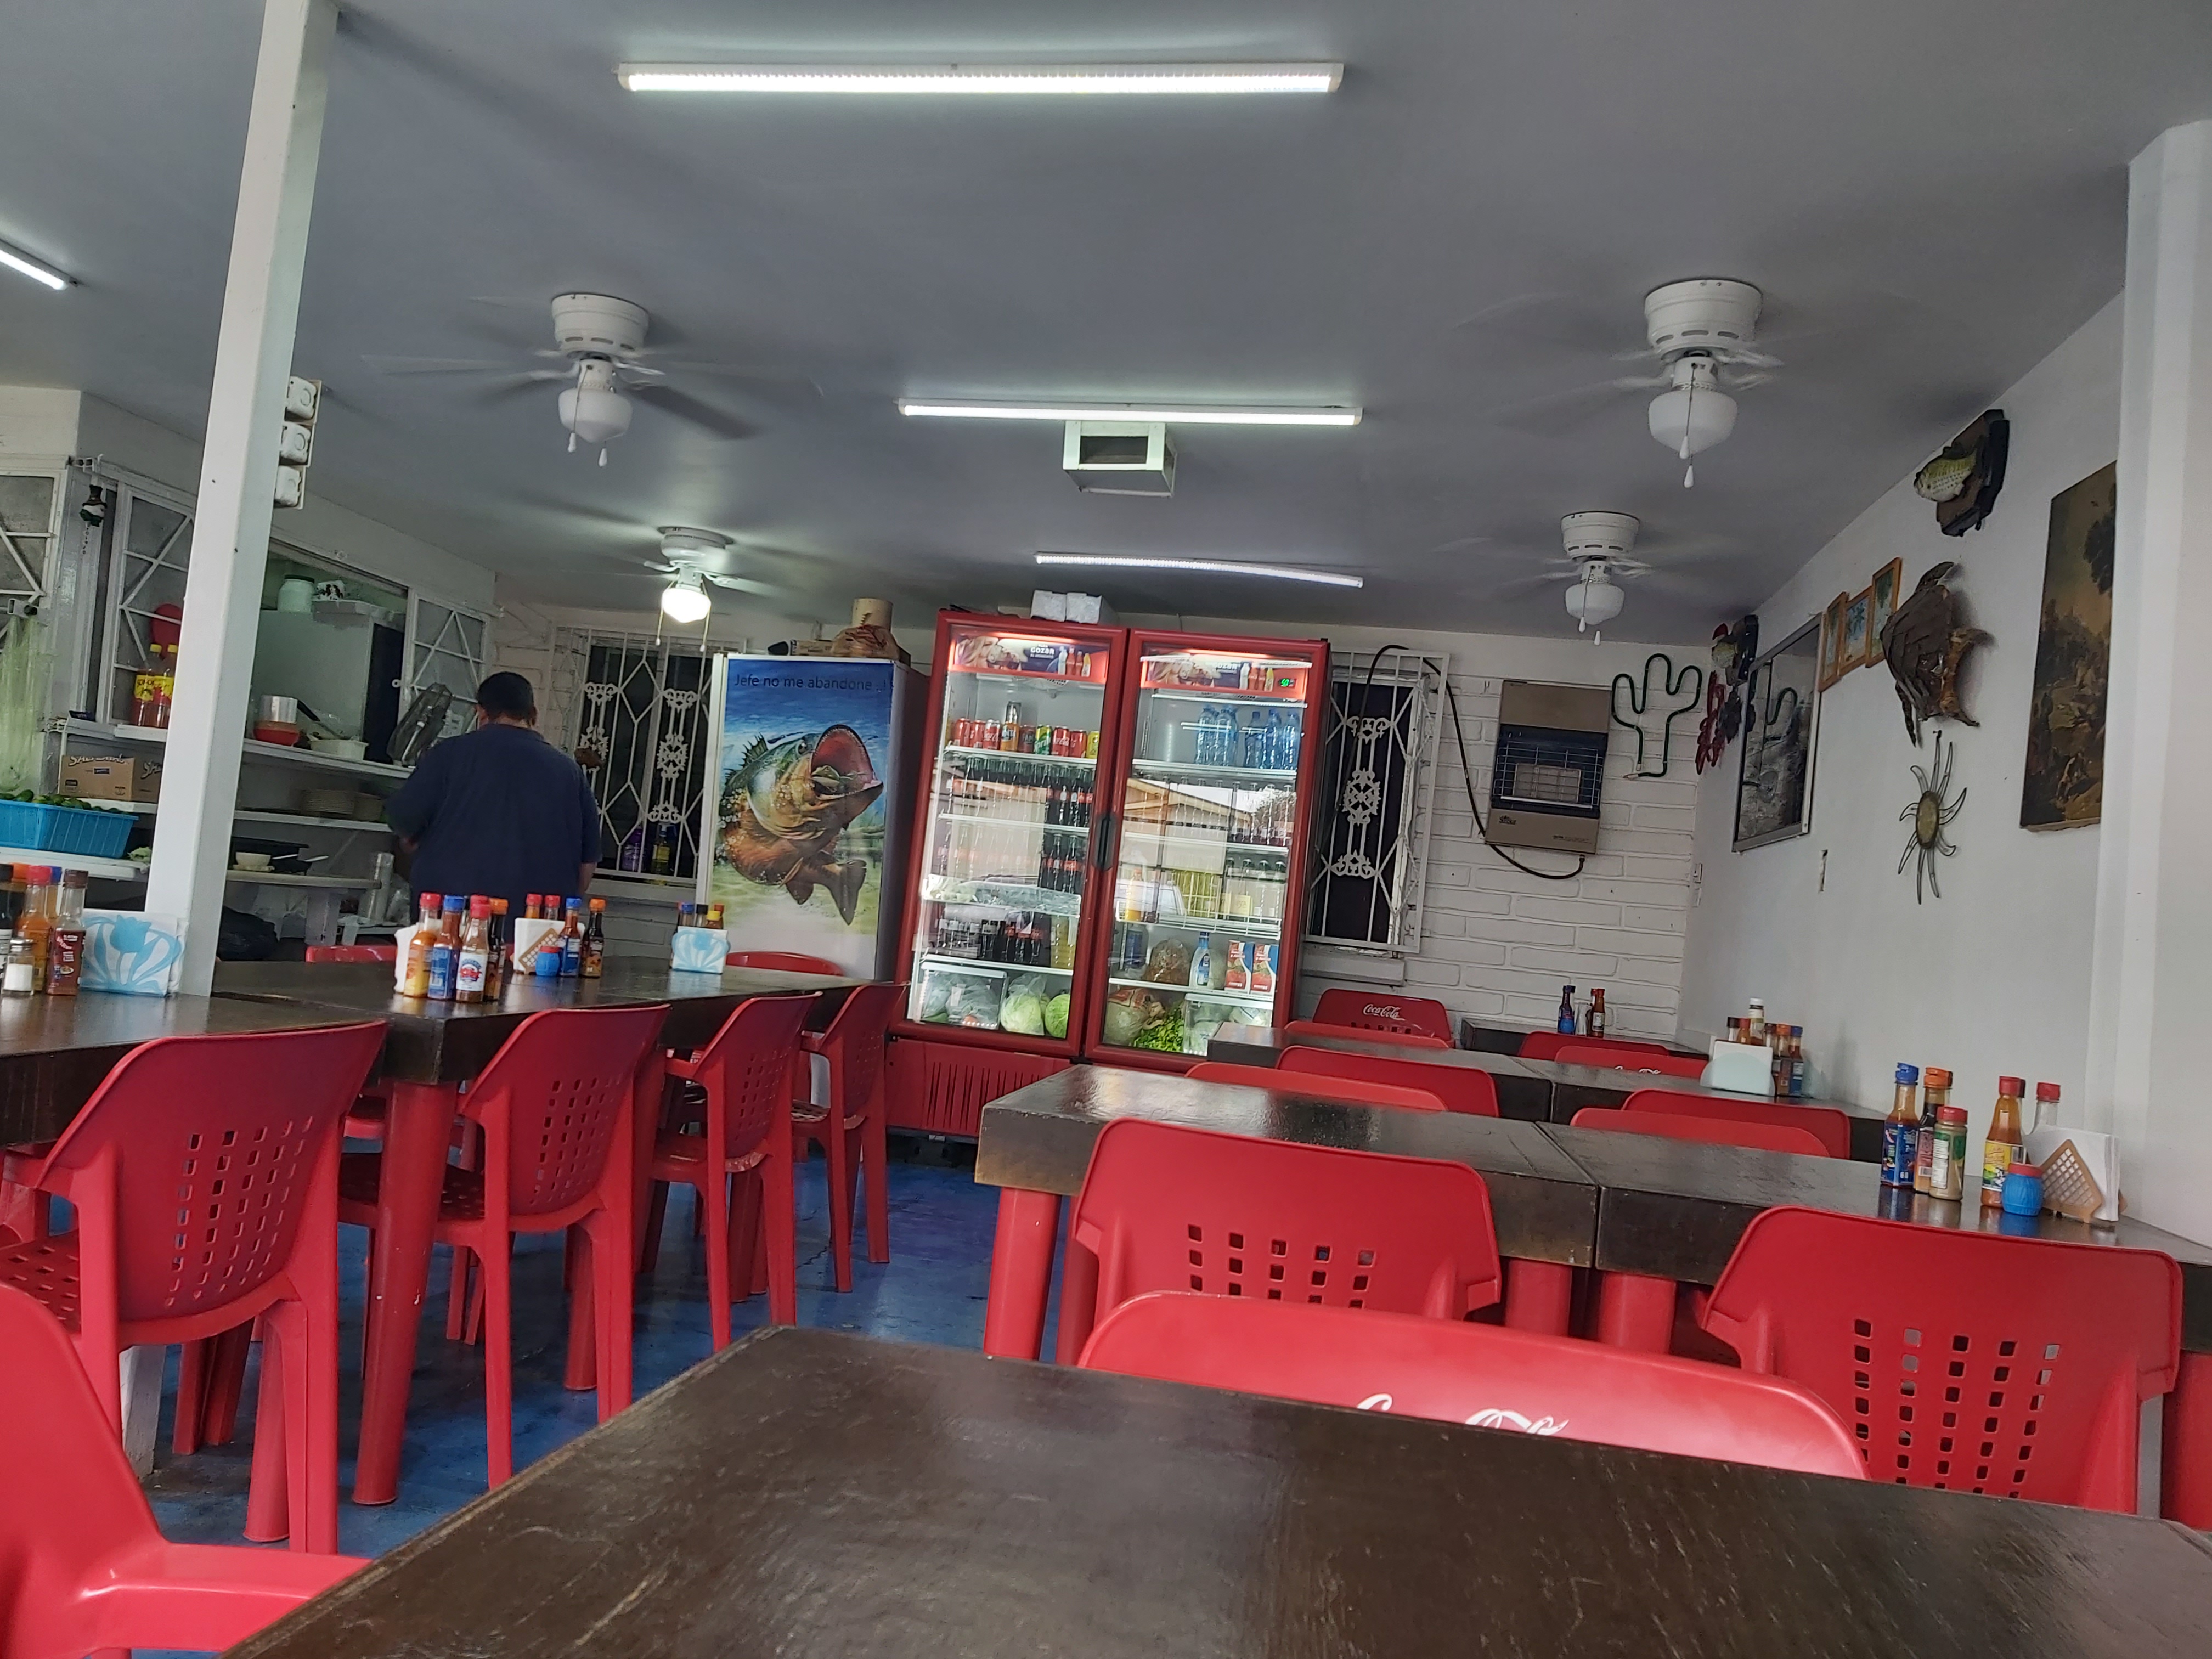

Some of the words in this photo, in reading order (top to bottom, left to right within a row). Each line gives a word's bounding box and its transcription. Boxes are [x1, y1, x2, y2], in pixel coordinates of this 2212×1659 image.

[734, 674, 759, 687] Jefe
[763, 677, 780, 687] no
[784, 678, 804, 688] me
[807, 676, 872, 690] abandone
[1363, 1004, 1405, 1021] Coca-Cola
